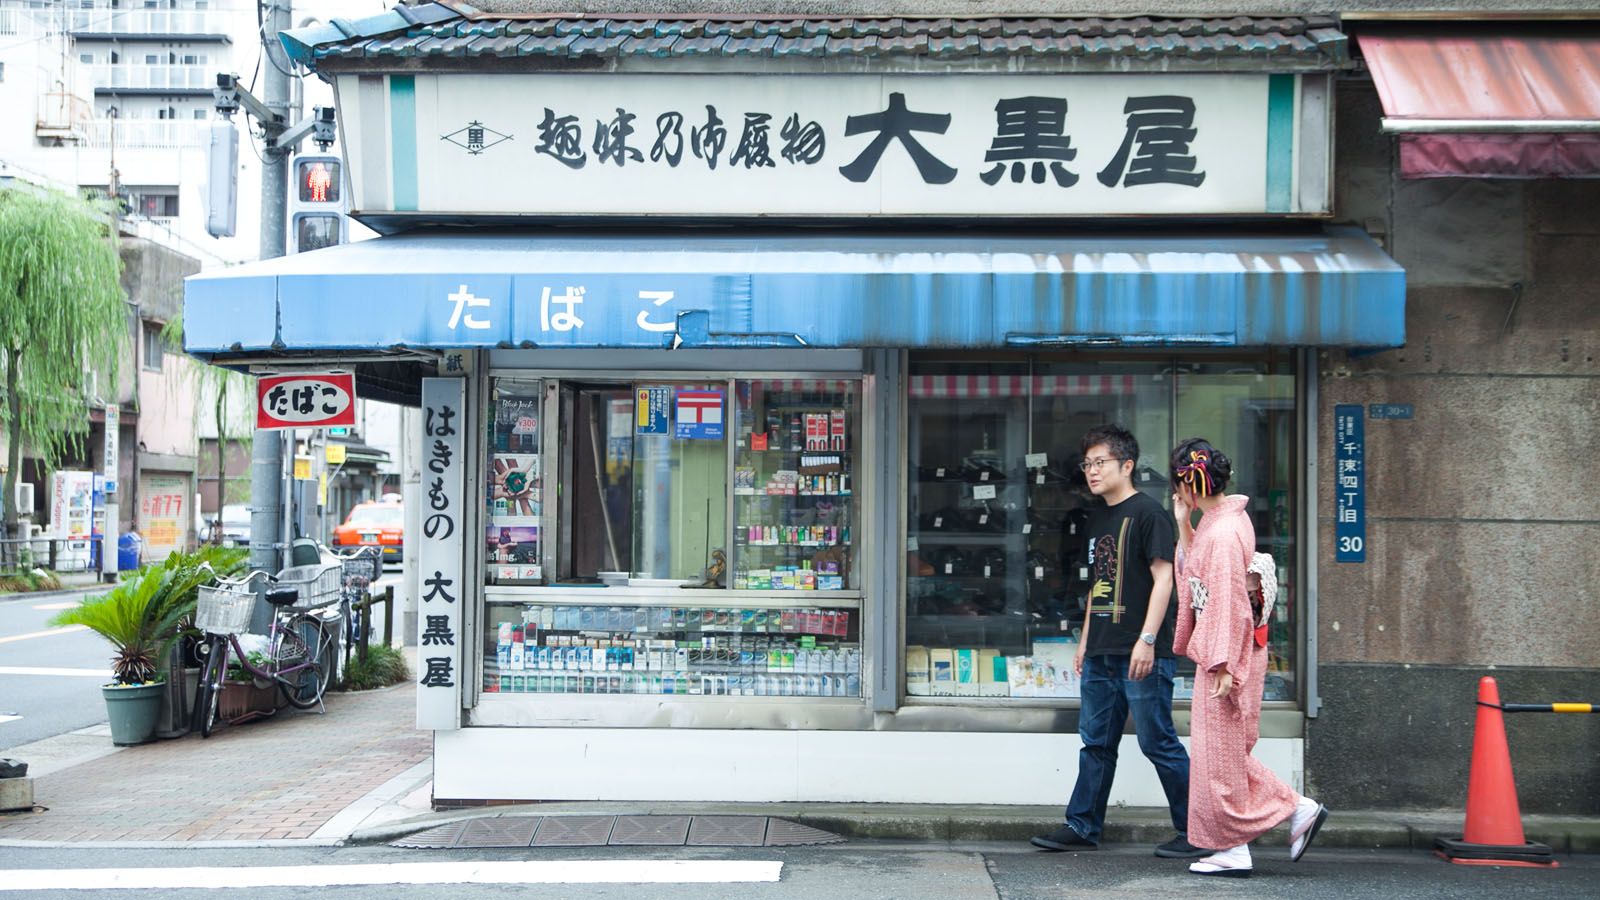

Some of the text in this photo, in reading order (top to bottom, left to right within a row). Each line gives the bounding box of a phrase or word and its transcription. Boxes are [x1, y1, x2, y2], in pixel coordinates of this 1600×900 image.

[838, 91, 1206, 188] 大黒屋
[447, 284, 677, 332] たばこ
[268, 383, 338, 416] たばこ
[420, 405, 456, 688] はきもの 大黒屋
[1340, 535, 1363, 553] 30
